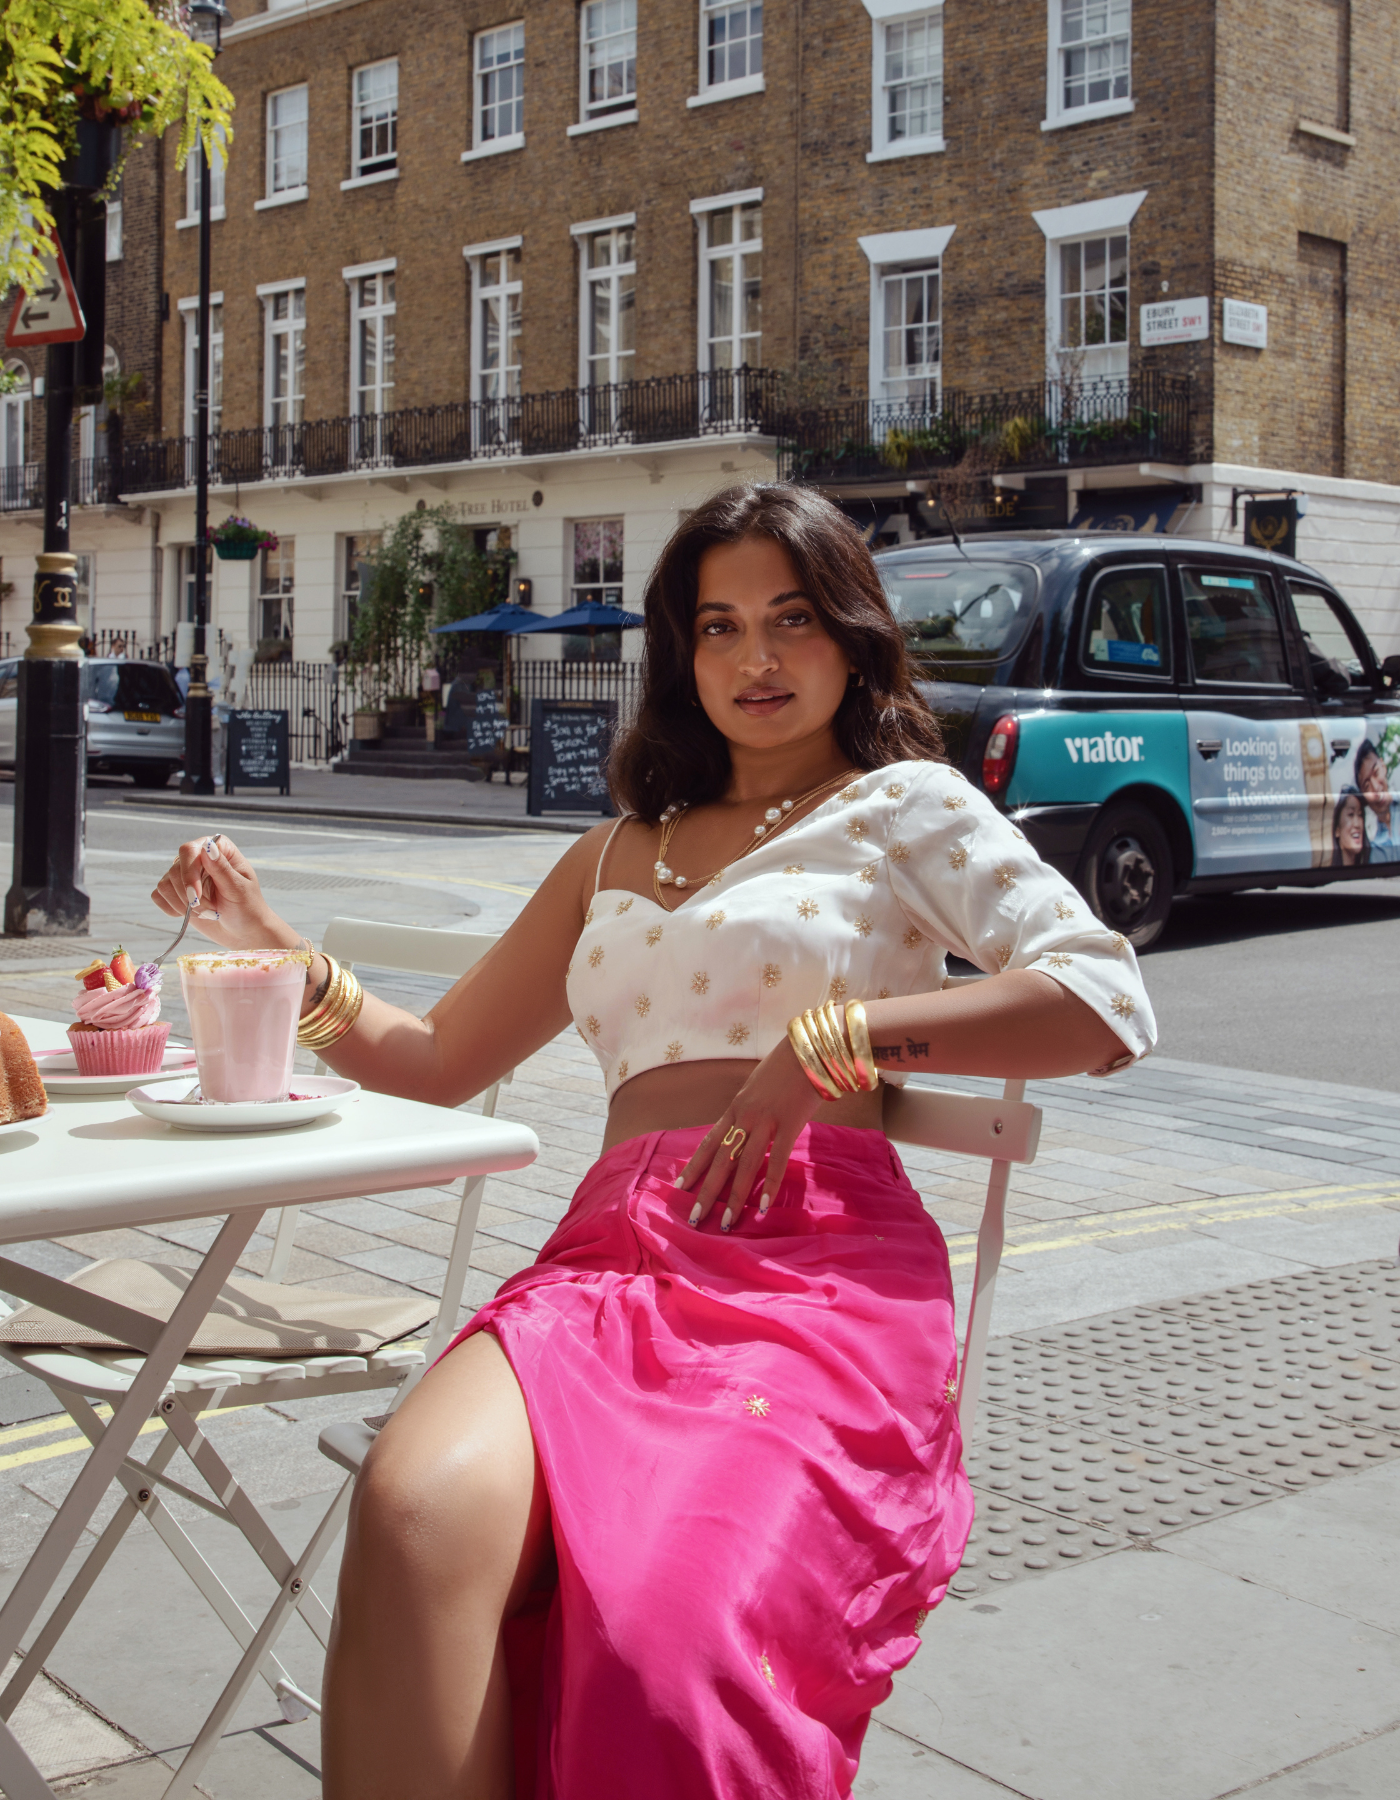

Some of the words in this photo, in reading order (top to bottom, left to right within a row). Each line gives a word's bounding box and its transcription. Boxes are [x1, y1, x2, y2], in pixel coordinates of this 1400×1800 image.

[1146, 306, 1175, 319] EBURY
[1146, 317, 1179, 332] STREET
[1182, 316, 1201, 327] SW1
[1228, 317, 1251, 331] STREET
[458, 501, 487, 518] TREE
[491, 498, 530, 515] HOTEL
[1226, 737, 1277, 761] Looking
[1279, 737, 1297, 755] for
[1223, 761, 1266, 787] things
[1267, 763, 1280, 780] to
[1283, 761, 1300, 780] do
[1227, 787, 1242, 806] in
[1242, 786, 1297, 806] London?
